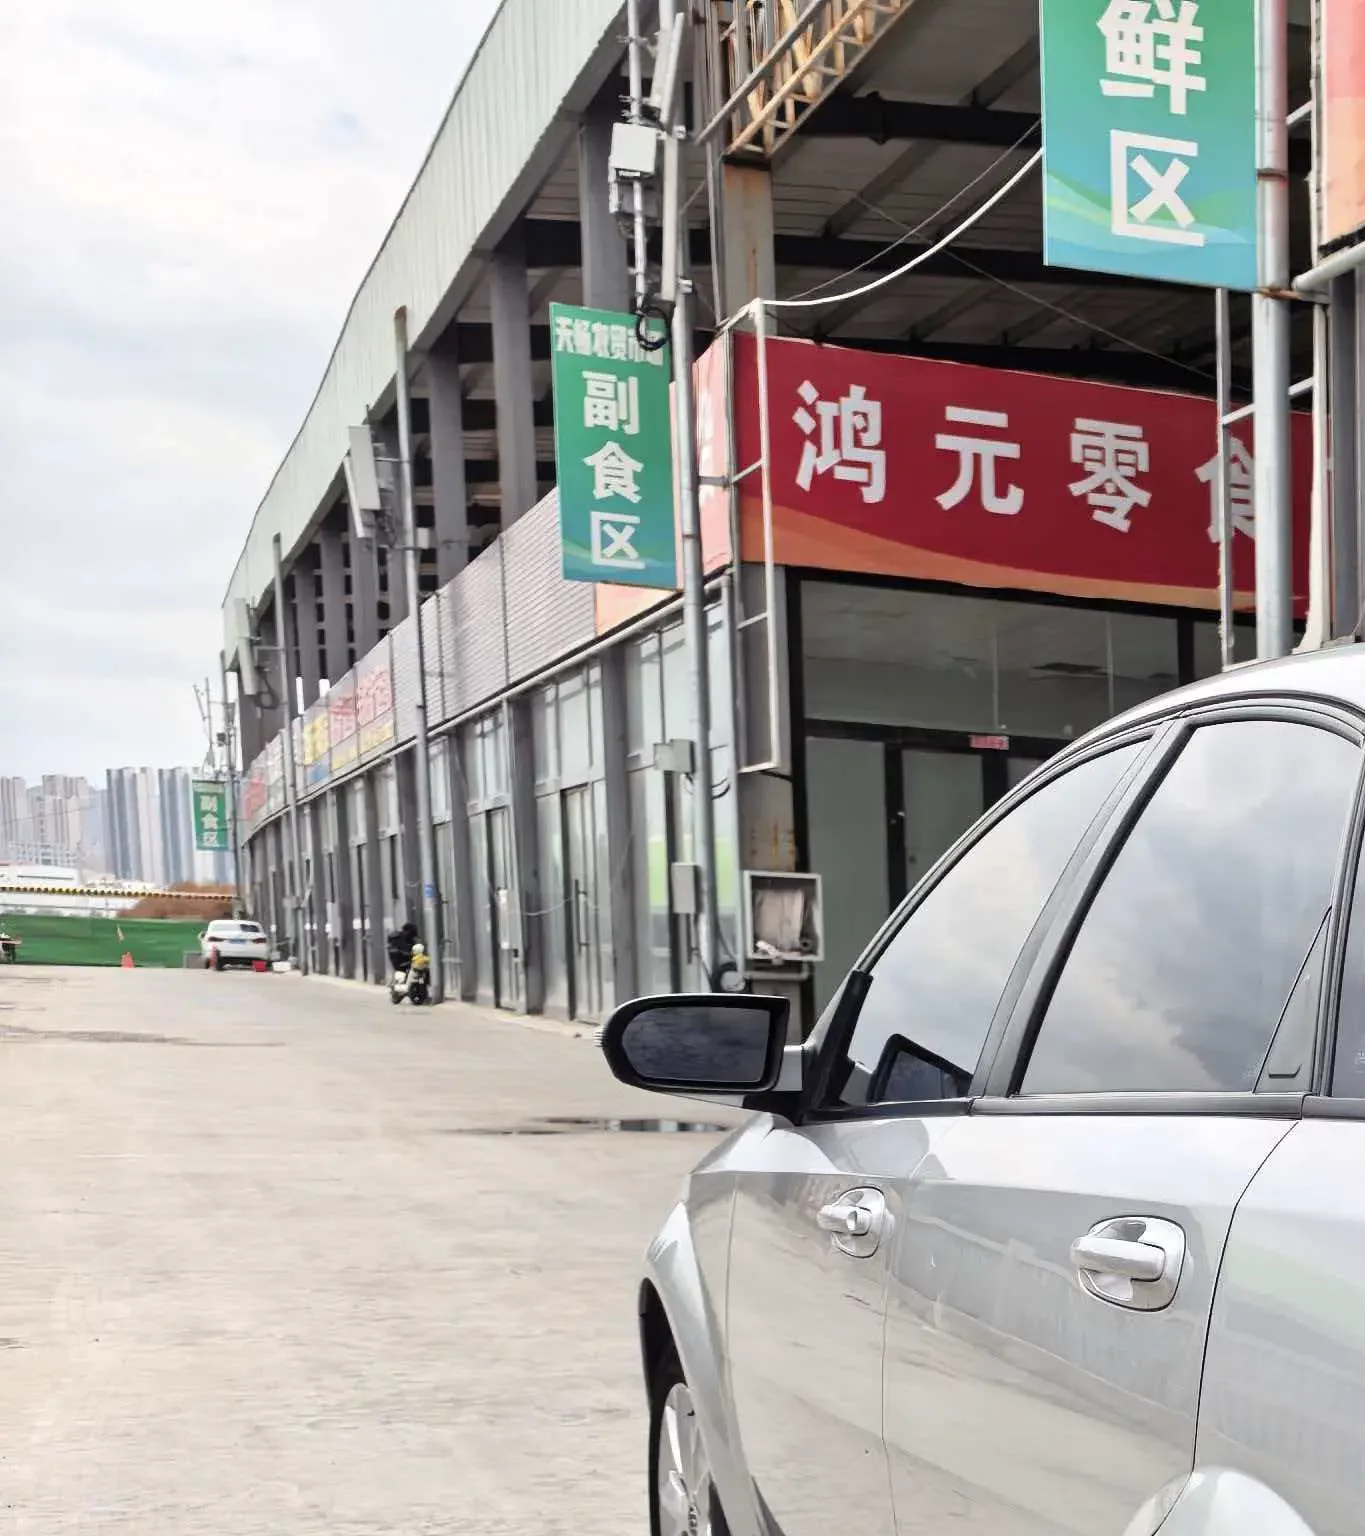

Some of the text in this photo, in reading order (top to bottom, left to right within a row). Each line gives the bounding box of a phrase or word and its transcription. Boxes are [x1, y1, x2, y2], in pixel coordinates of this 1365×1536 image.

[1097, 0, 1206, 247] 鲜区
[582, 370, 647, 570] 副食区
